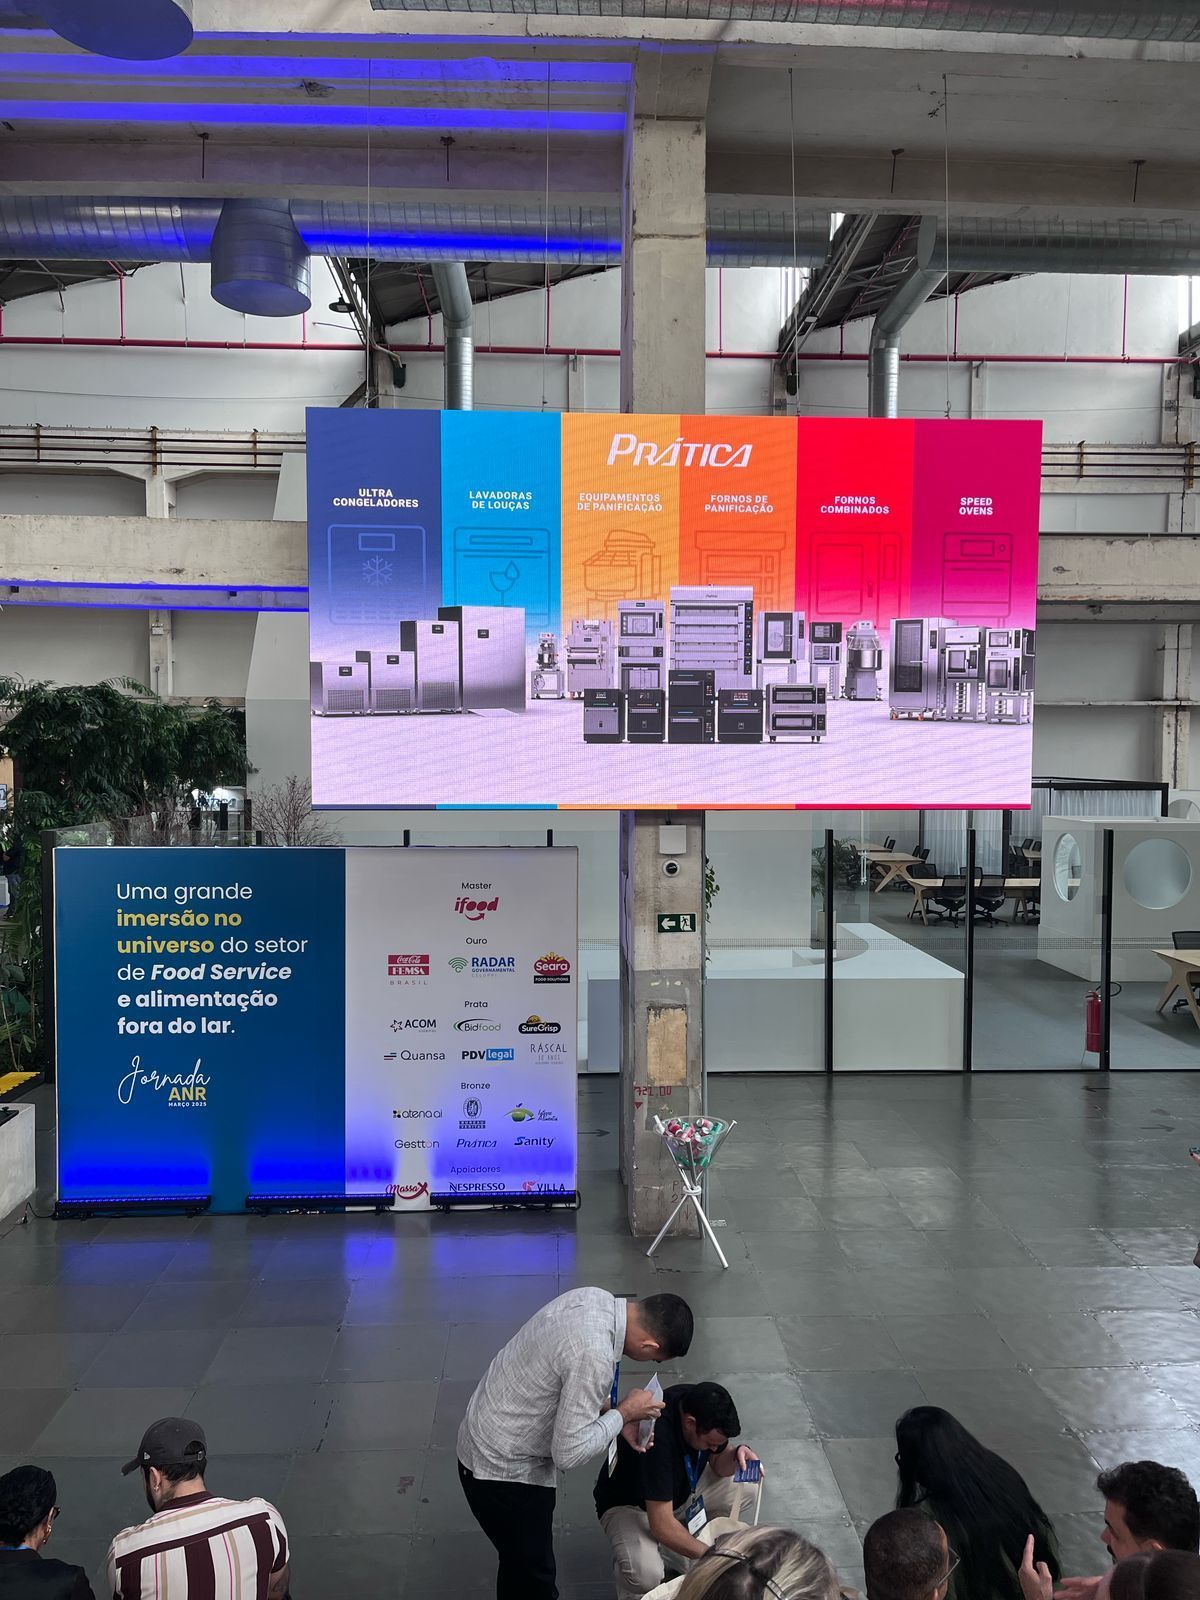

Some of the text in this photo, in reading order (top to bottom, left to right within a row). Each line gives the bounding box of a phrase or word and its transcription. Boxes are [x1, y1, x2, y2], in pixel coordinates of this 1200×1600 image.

[358, 488, 394, 498] ULTRA
[469, 490, 533, 501] LAVADORAS
[579, 492, 661, 503] EQUIPAMENTOS
[333, 497, 419, 508] CONGELADORES
[710, 494, 768, 504] FORNOS DE
[834, 496, 876, 505] FORNOS
[960, 497, 993, 506] SPEED
[472, 500, 530, 512] DE LOUÇAS
[577, 501, 663, 513] DE PANIFICAÇÃO
[704, 503, 774, 515] PANIFICAÇÃO
[820, 504, 890, 515] COMBINADOS
[958, 506, 994, 516] OVENS
[461, 882, 492, 890] Master
[116, 882, 253, 905] Uma grande
[454, 896, 499, 914] ifood
[116, 908, 242, 927] imersão no
[117, 935, 308, 954] universo do setor
[465, 937, 488, 945] Ouro
[471, 957, 515, 967] RADAR
[535, 961, 568, 971] Seara
[117, 962, 292, 981] de Food Service
[392, 966, 426, 975] FEMSA
[117, 989, 278, 1012] e alimentação
[464, 1000, 488, 1008] Prata
[117, 1016, 235, 1035] fora do lar.
[404, 1019, 437, 1028] ACOM
[464, 1023, 501, 1032] Bidfood
[400, 1050, 446, 1061] Quansa
[117, 1055, 211, 1104] Jornada
[460, 1082, 491, 1090] Bronze
[168, 1086, 207, 1101] ANR
[394, 1139, 440, 1149] Gestton
[514, 1136, 554, 1148] Sanity
[450, 1166, 501, 1175] Apoiadores
[450, 1182, 506, 1192] NESPRESSO
[537, 1183, 566, 1192] VILLA
